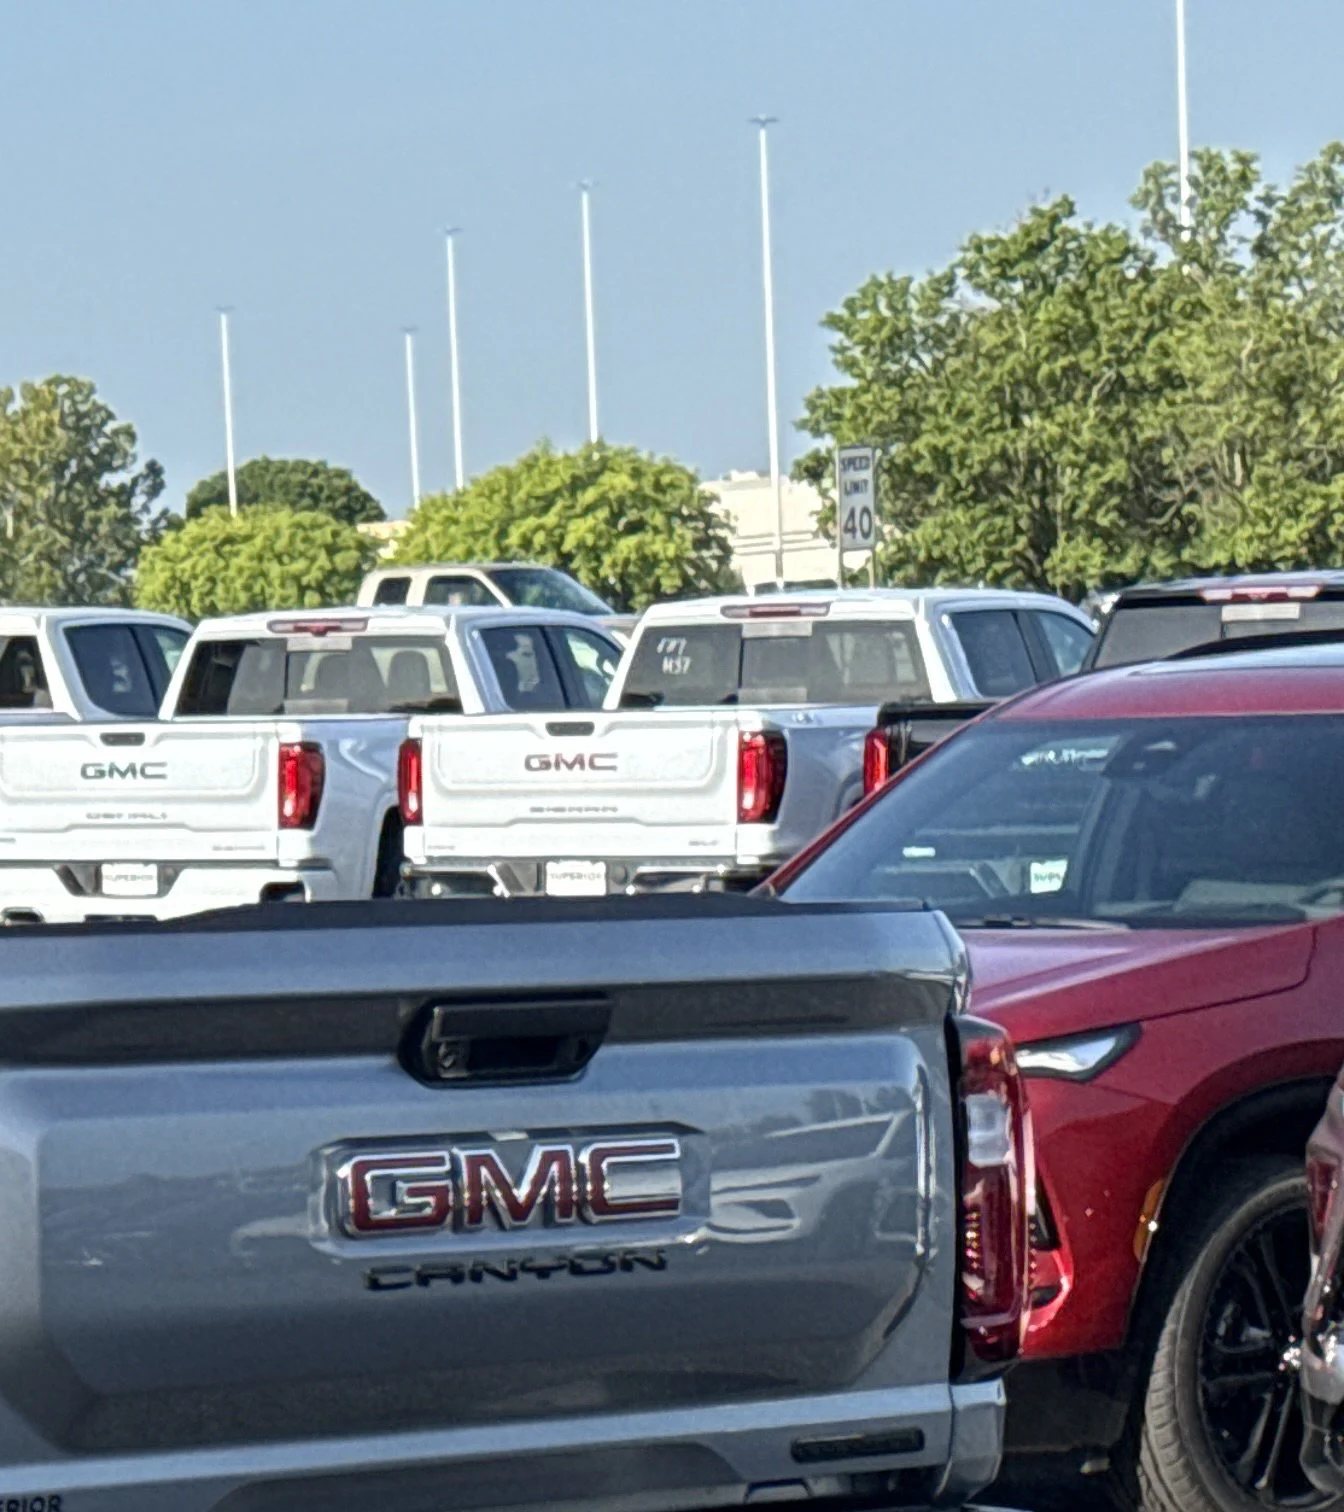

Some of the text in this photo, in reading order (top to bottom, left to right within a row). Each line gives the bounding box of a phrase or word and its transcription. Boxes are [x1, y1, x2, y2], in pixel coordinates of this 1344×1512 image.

[841, 455, 870, 472] SPEED
[844, 479, 869, 495] LIMIT
[843, 505, 873, 540] 40
[80, 762, 169, 780] GMC
[524, 753, 618, 772] GMC
[335, 1137, 681, 1237] GMC
[364, 1248, 668, 1292] CANYON
